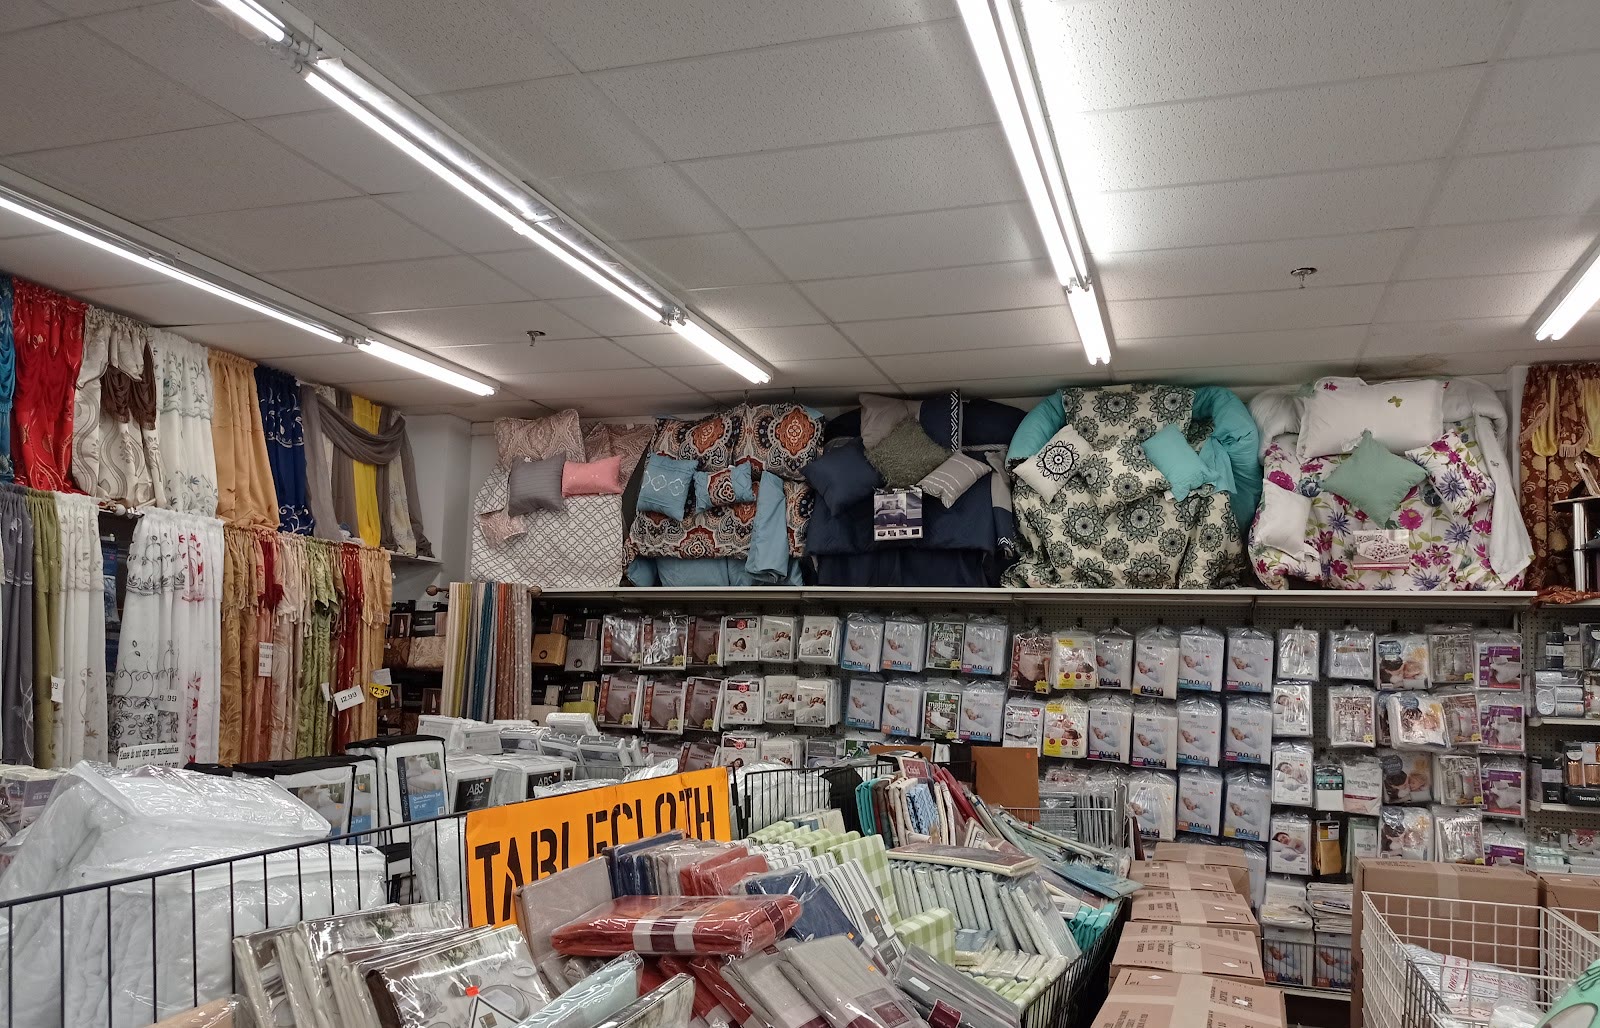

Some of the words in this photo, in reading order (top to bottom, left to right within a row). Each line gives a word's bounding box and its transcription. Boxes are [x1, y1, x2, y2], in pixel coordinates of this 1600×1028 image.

[340, 692, 358, 703] 12.99
[928, 701, 956, 709] mattress
[130, 749, 135, 758] do
[142, 749, 150, 760] open
[538, 775, 553, 786] ABS
[467, 782, 485, 796] ABS
[475, 785, 716, 925] TABLECLOTH
